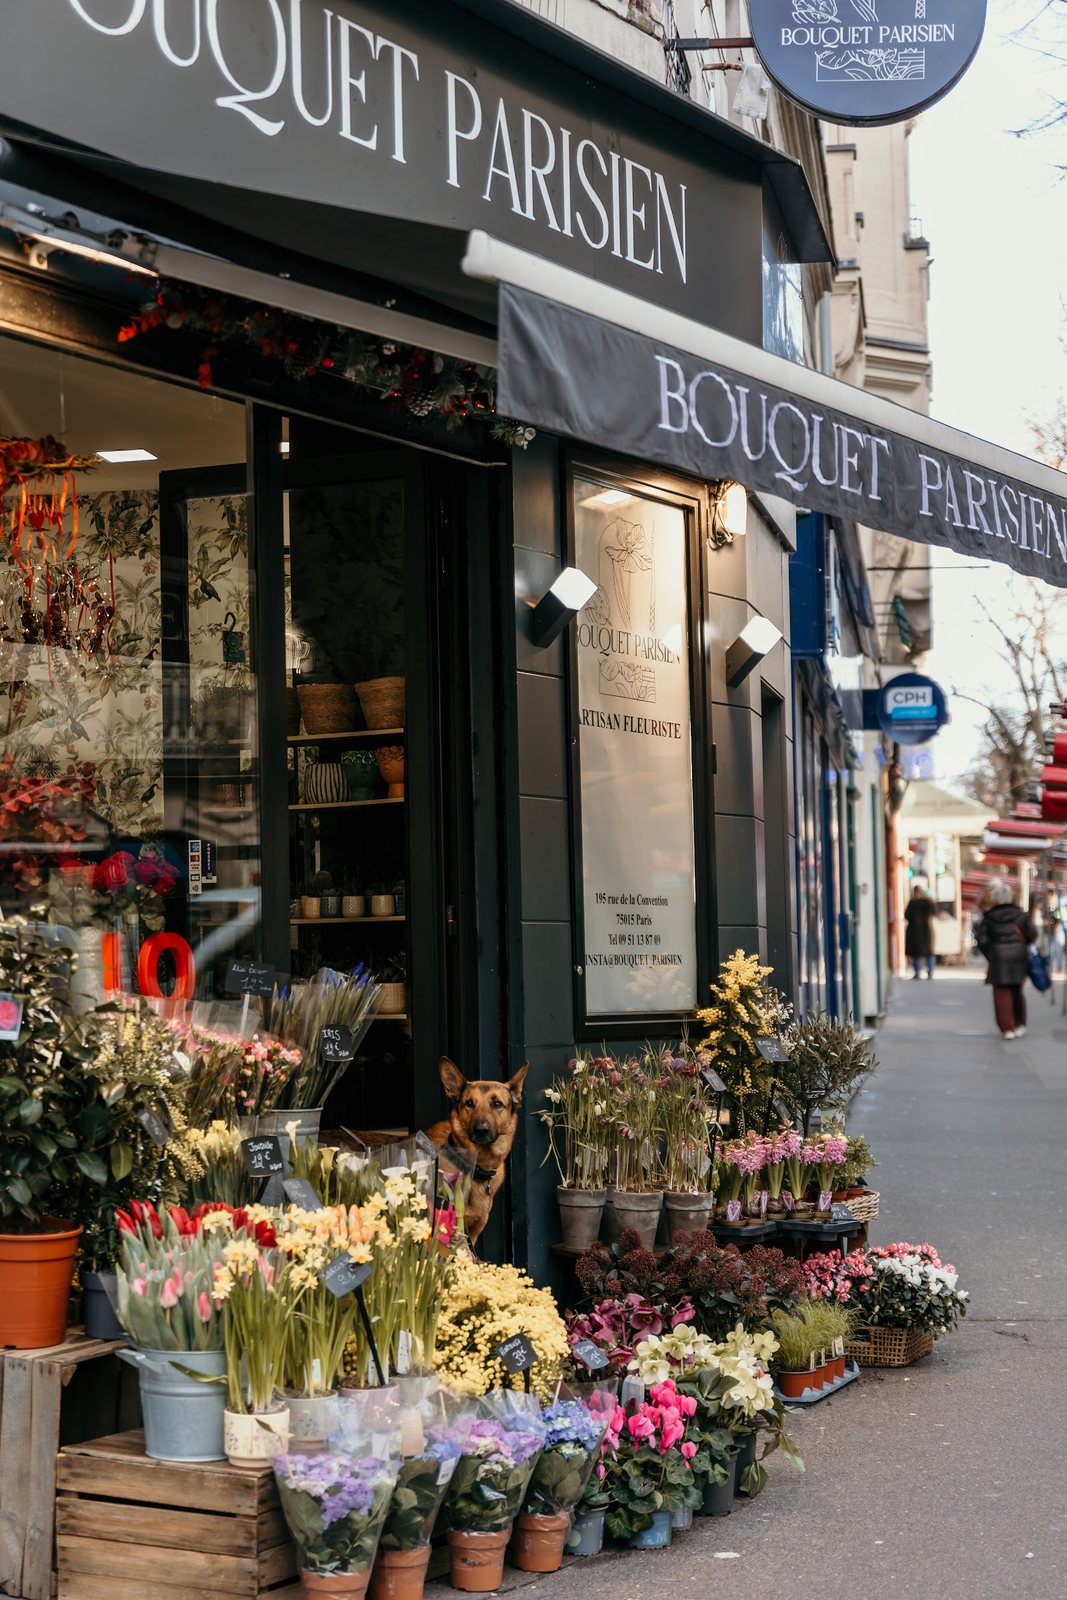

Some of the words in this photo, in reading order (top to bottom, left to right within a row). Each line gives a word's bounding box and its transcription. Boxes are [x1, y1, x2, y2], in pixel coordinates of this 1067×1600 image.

[781, 26, 873, 48] BOUQUET
[879, 24, 955, 44] PARISIEN
[67, 0, 420, 165] UQUET
[444, 70, 687, 285] PARISIEN
[654, 354, 890, 501] BOUQUET
[918, 453, 1067, 563] PARISIEN
[577, 623, 632, 657] OUQUET
[893, 691, 926, 704] CPH
[623, 714, 682, 739] FLEURISTE
[595, 892, 606, 905] 195
[608, 895, 619, 905] rue
[620, 893, 628, 905] de
[629, 893, 636, 905] la
[636, 893, 669, 907] Convention
[616, 913, 635, 926] 75015
[636, 914, 653, 926] Paris
[618, 934, 626, 946] 09
[627, 934, 635, 946] 51
[637, 934, 644, 946] 13
[321, 1029, 341, 1041] IRIS
